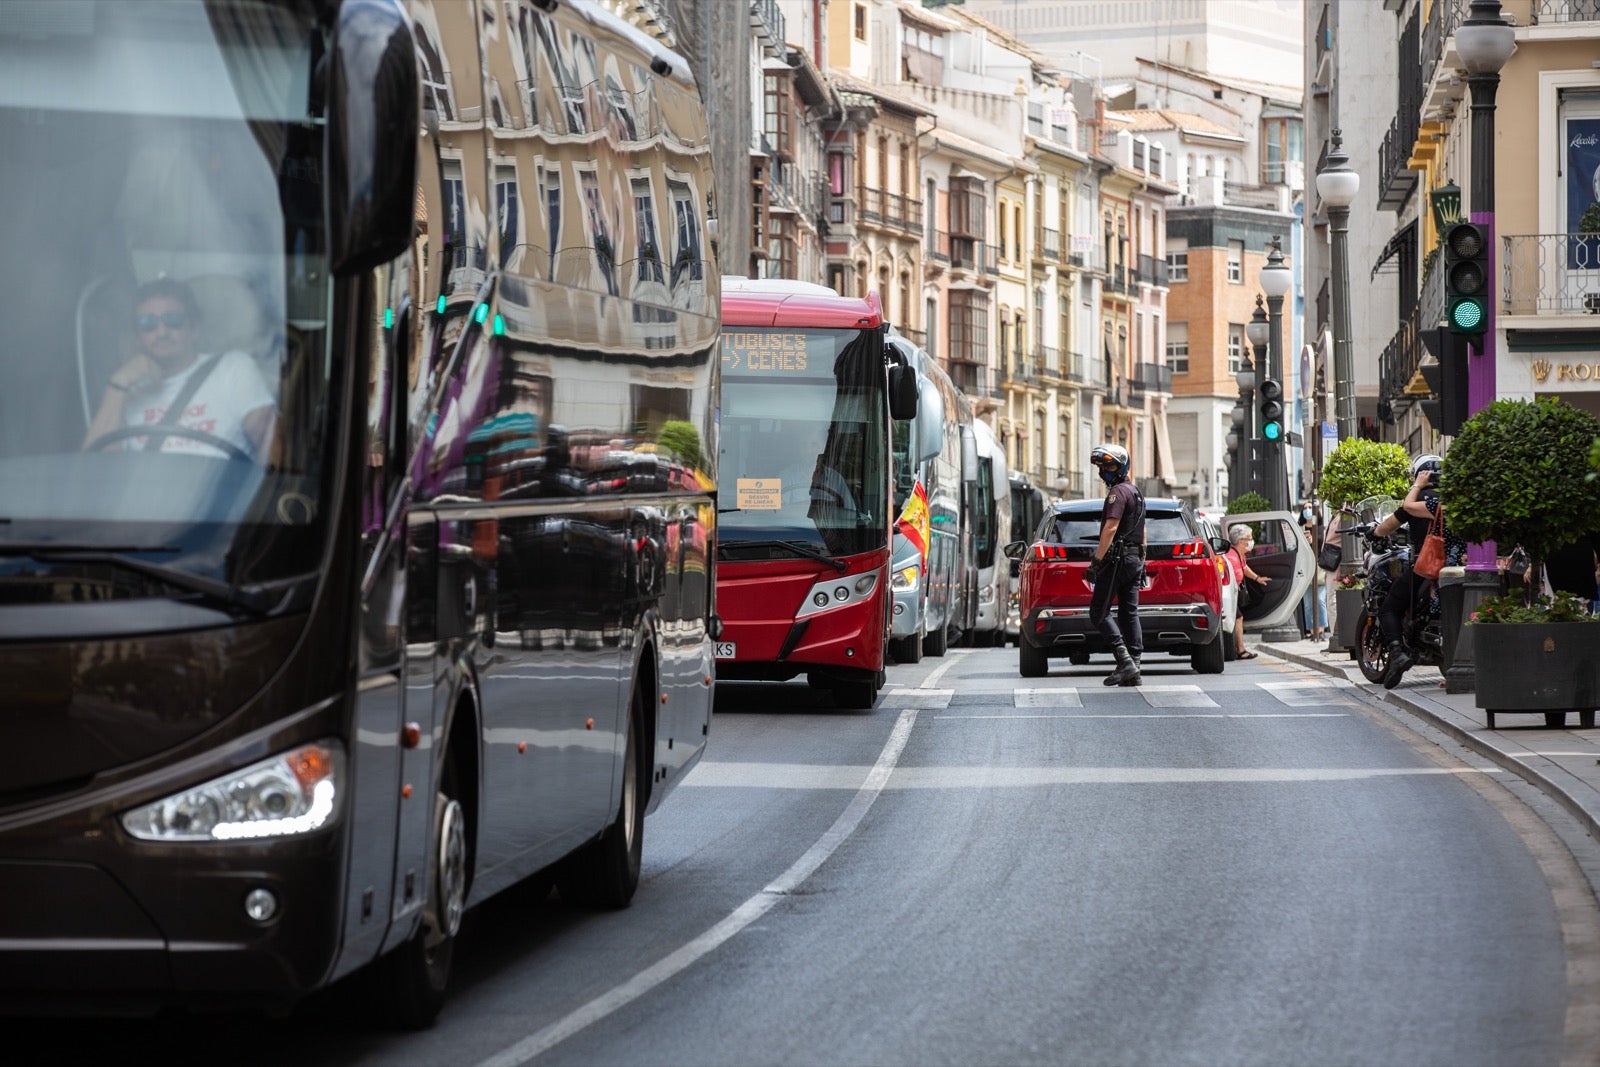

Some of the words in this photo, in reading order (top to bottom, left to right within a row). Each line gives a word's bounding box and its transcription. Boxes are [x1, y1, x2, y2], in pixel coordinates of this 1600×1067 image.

[720, 333, 807, 350] TOBUSES
[747, 351, 807, 370] CENES
[716, 643, 733, 656] KS
